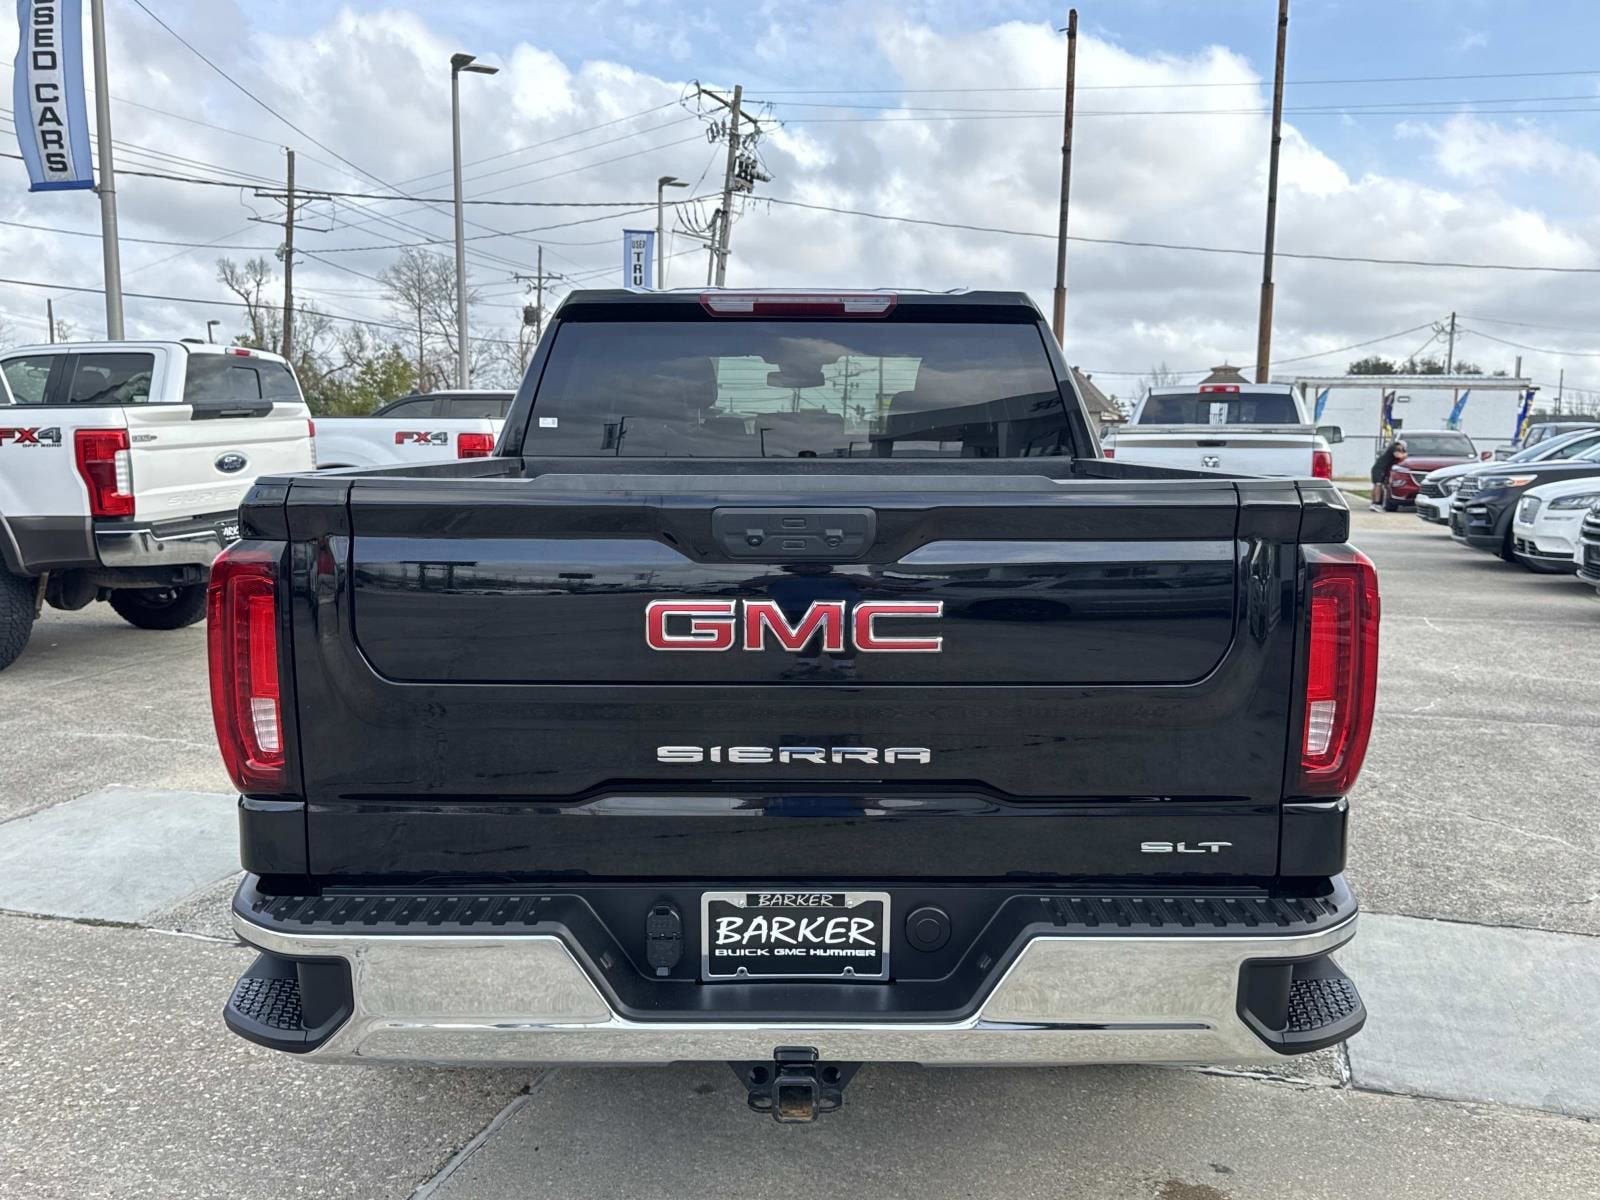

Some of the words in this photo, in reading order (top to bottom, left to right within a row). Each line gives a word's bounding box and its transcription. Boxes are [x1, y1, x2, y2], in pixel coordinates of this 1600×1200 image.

[33, 0, 57, 70] SED
[34, 83, 68, 172] CARS
[395, 431, 448, 444] FX4
[646, 599, 944, 652] GMC
[657, 746, 931, 764] SIERRA
[1140, 841, 1233, 853] SLT
[757, 894, 834, 906] BARKER
[715, 915, 876, 945] BARKER
[715, 948, 770, 956] BUICK
[773, 948, 807, 956] GMC
